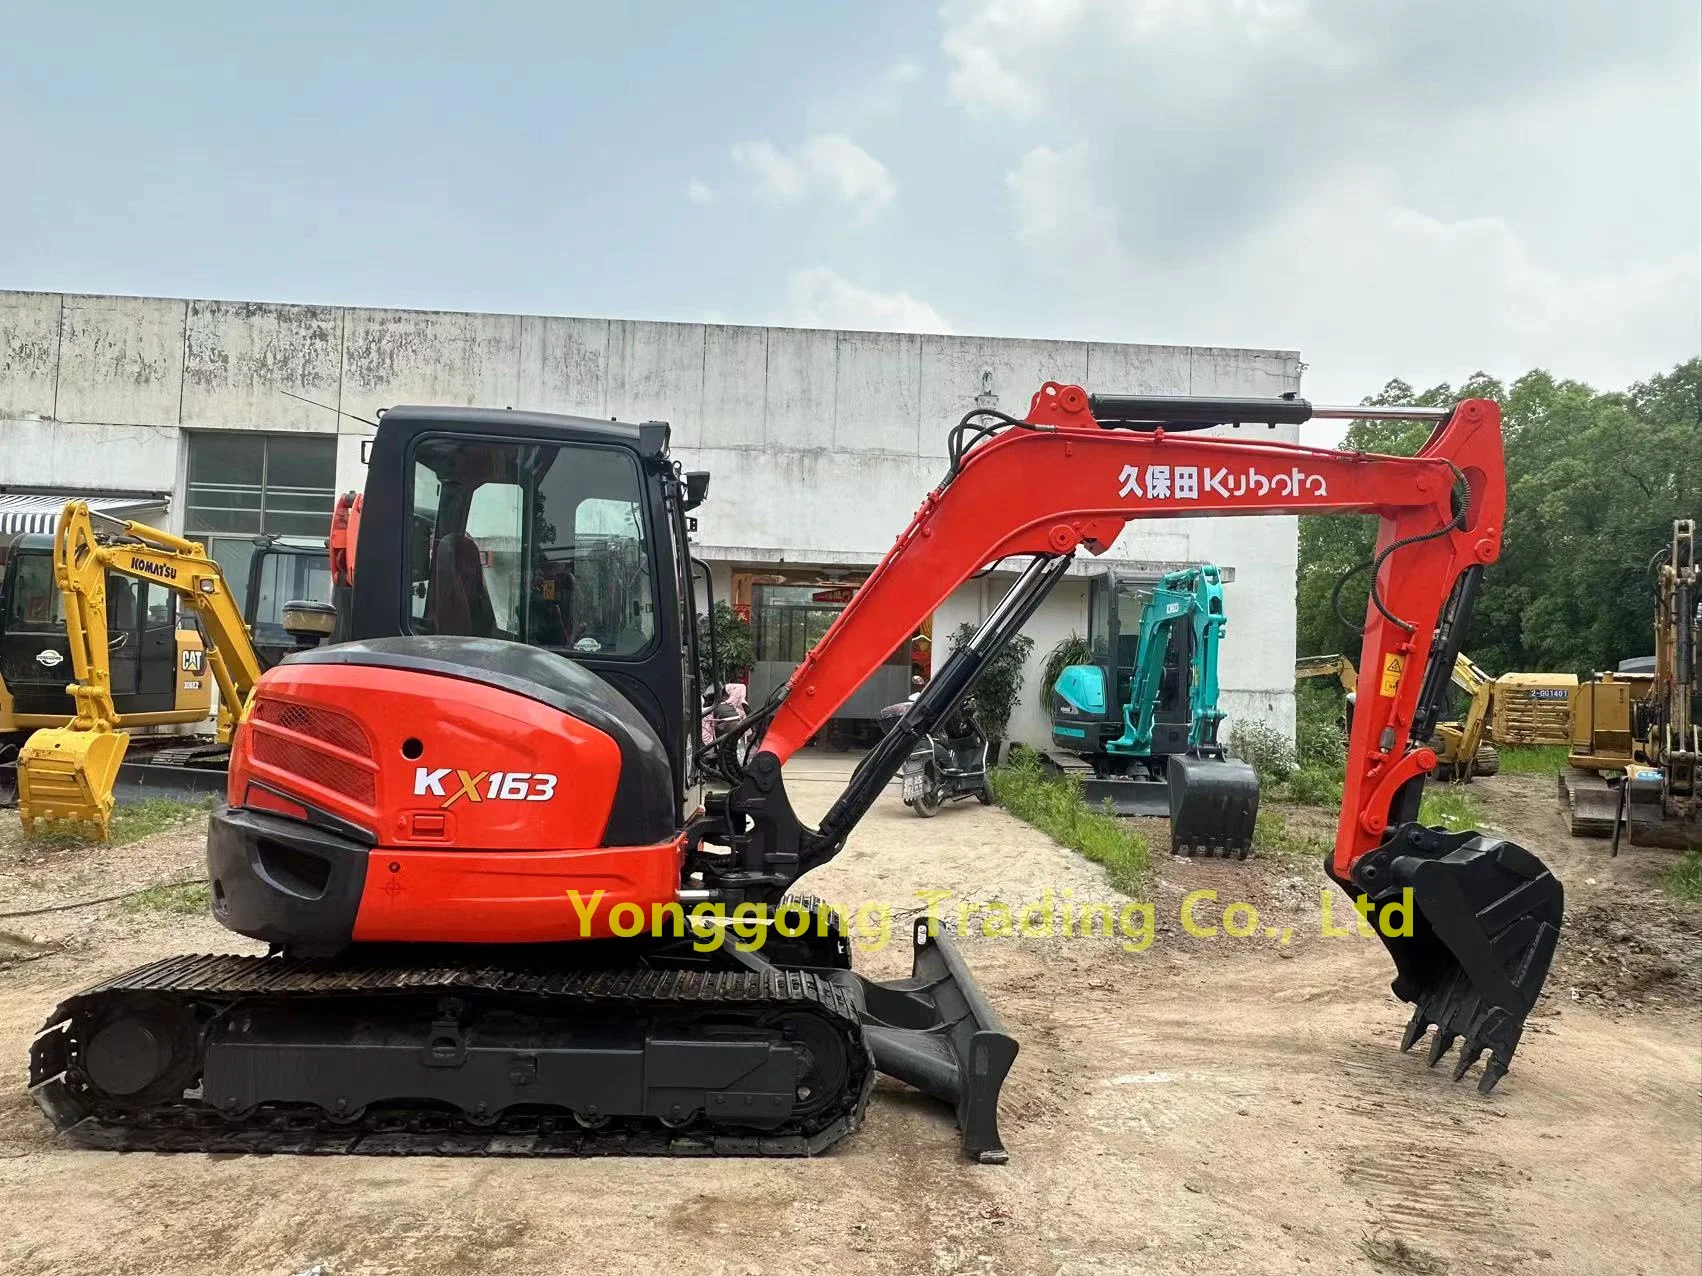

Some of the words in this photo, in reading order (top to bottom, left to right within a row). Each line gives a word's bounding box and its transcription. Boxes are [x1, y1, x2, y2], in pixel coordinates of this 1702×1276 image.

[1118, 464, 1199, 499] 久保田
[1203, 466, 1328, 499] Kubota
[131, 556, 177, 579] KOMATSU
[182, 650, 202, 671] CAT
[413, 767, 558, 808] KX163
